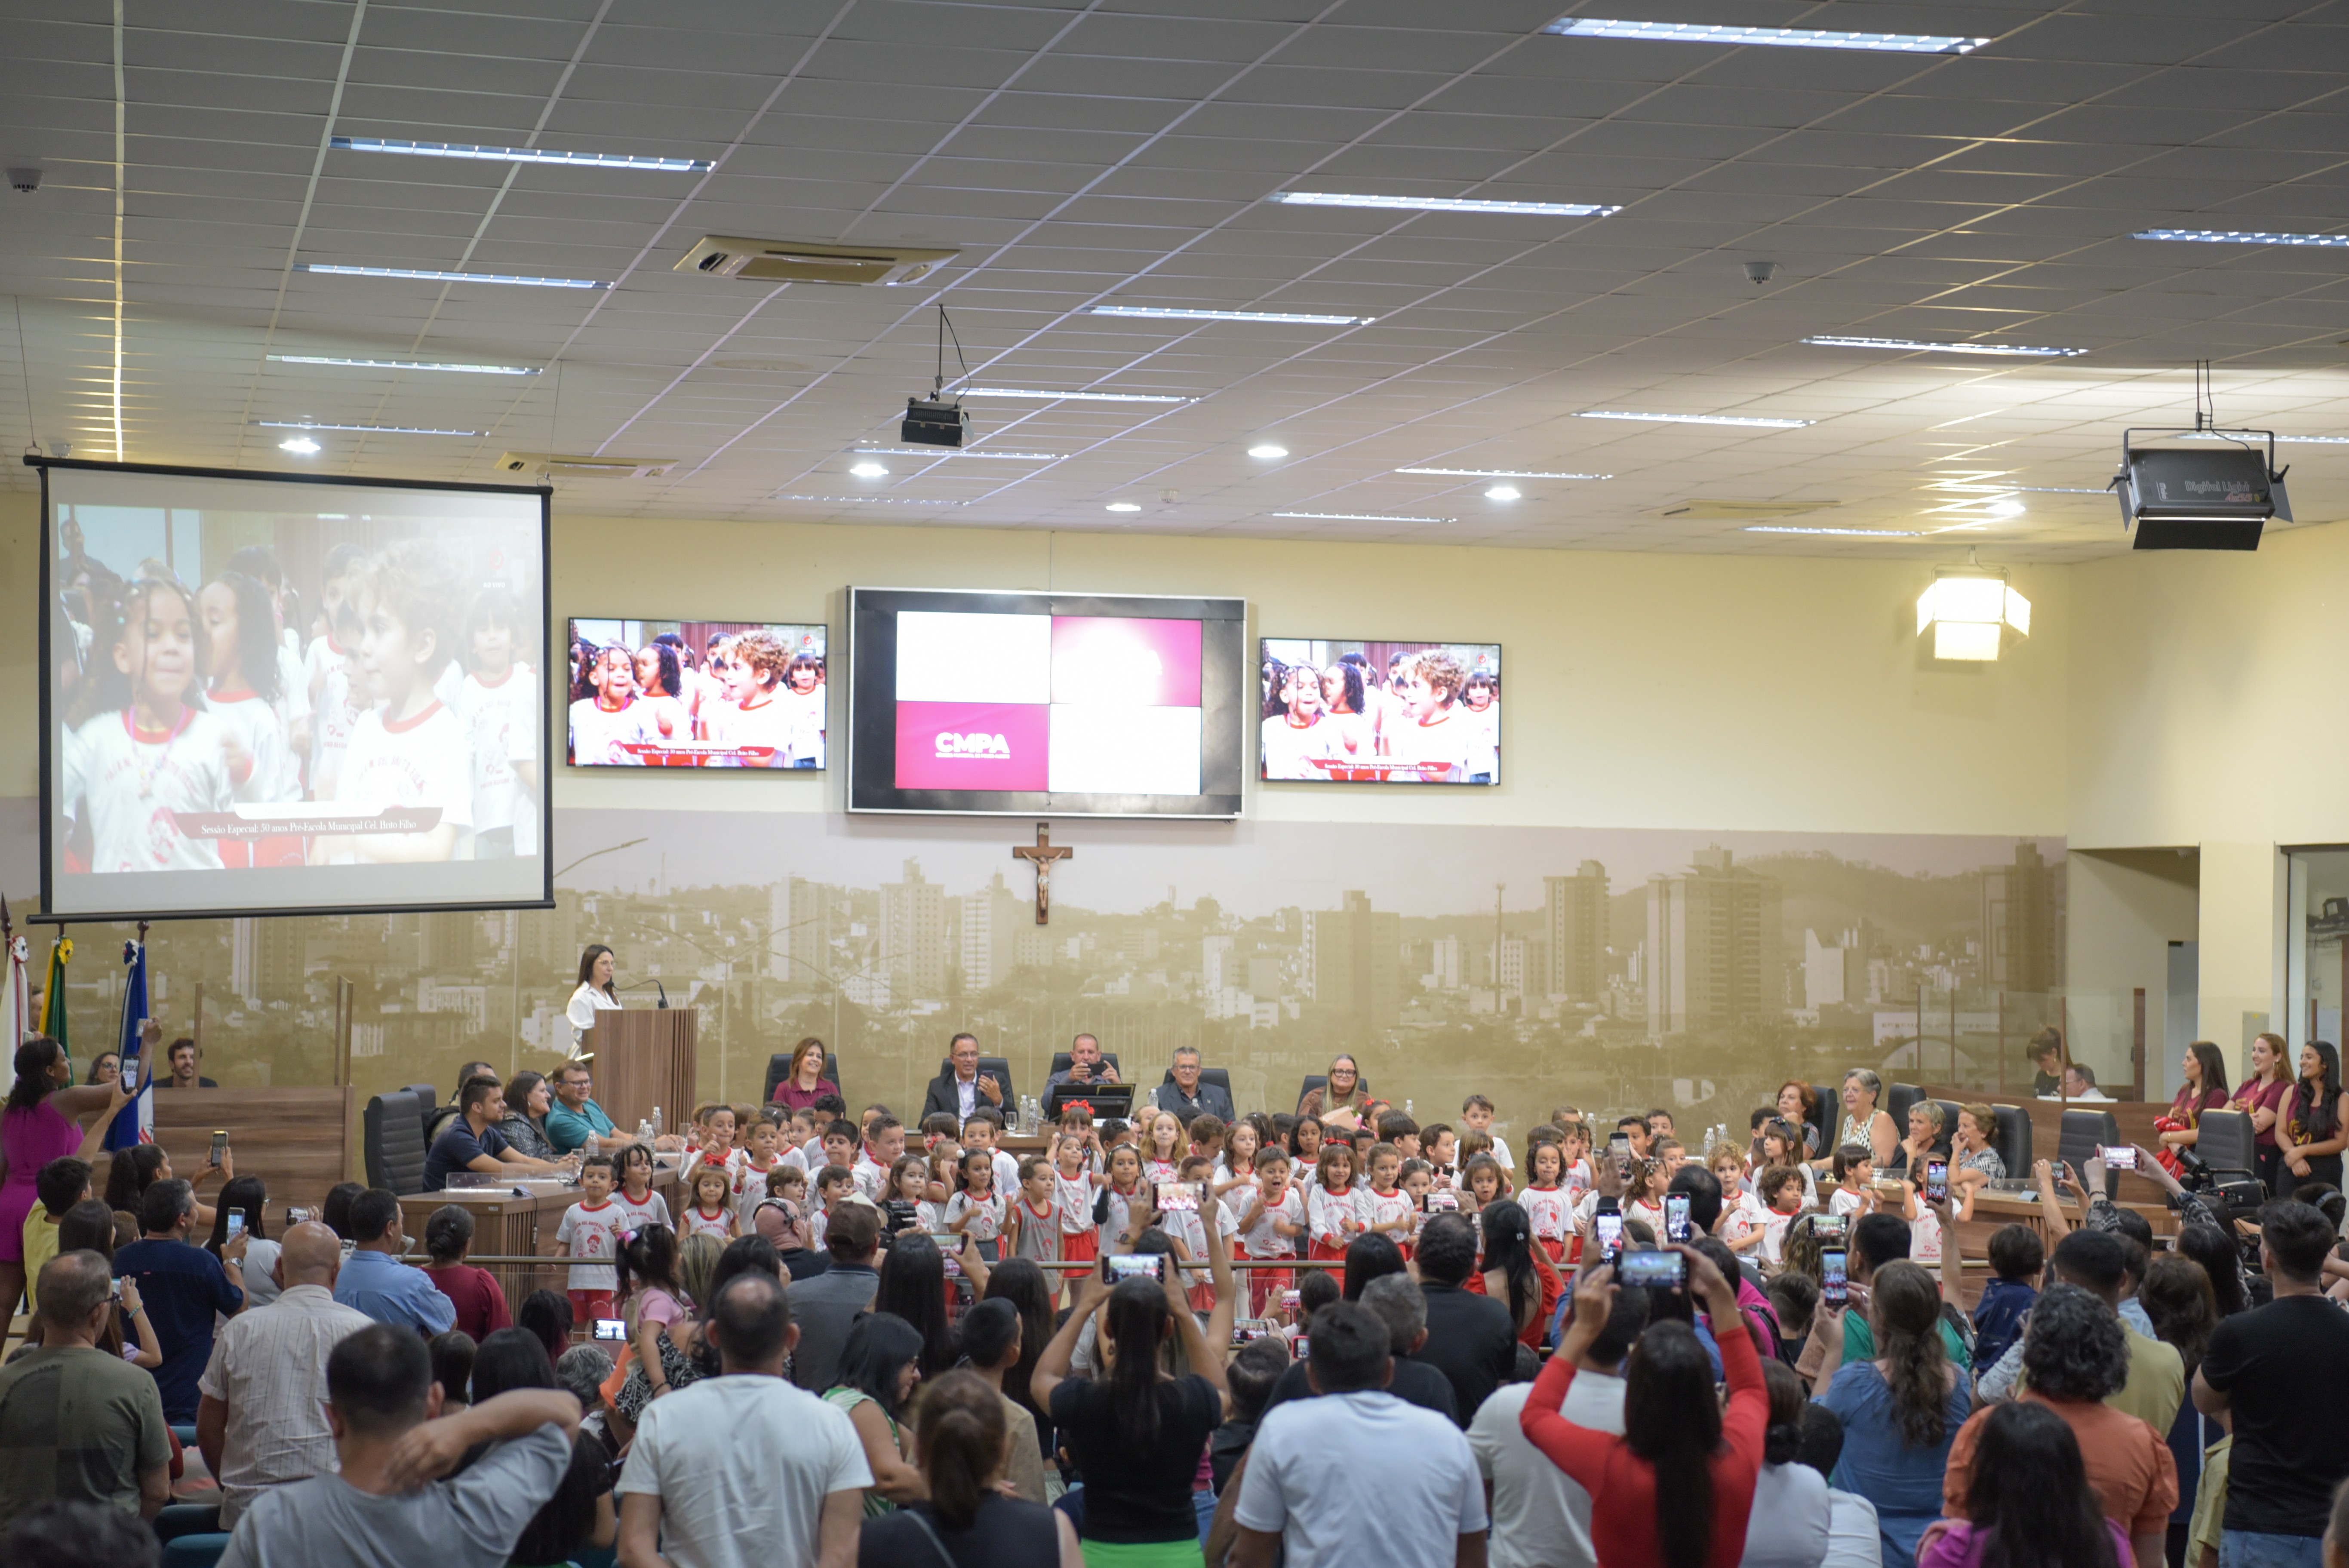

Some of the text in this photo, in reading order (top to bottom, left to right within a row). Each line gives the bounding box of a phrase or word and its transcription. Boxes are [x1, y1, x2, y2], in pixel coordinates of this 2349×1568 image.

[2184, 480, 2250, 494] Digital Light
[935, 732, 1010, 753] CMPA
[201, 824, 225, 834] Sessão
[228, 823, 258, 836] Especial:
[261, 823, 270, 833] 50
[290, 821, 326, 832] Pré-Escola
[328, 821, 363, 832] Municipal
[364, 819, 378, 830] Cel.
[380, 820, 397, 829] Brito
[399, 819, 416, 828] Filho
